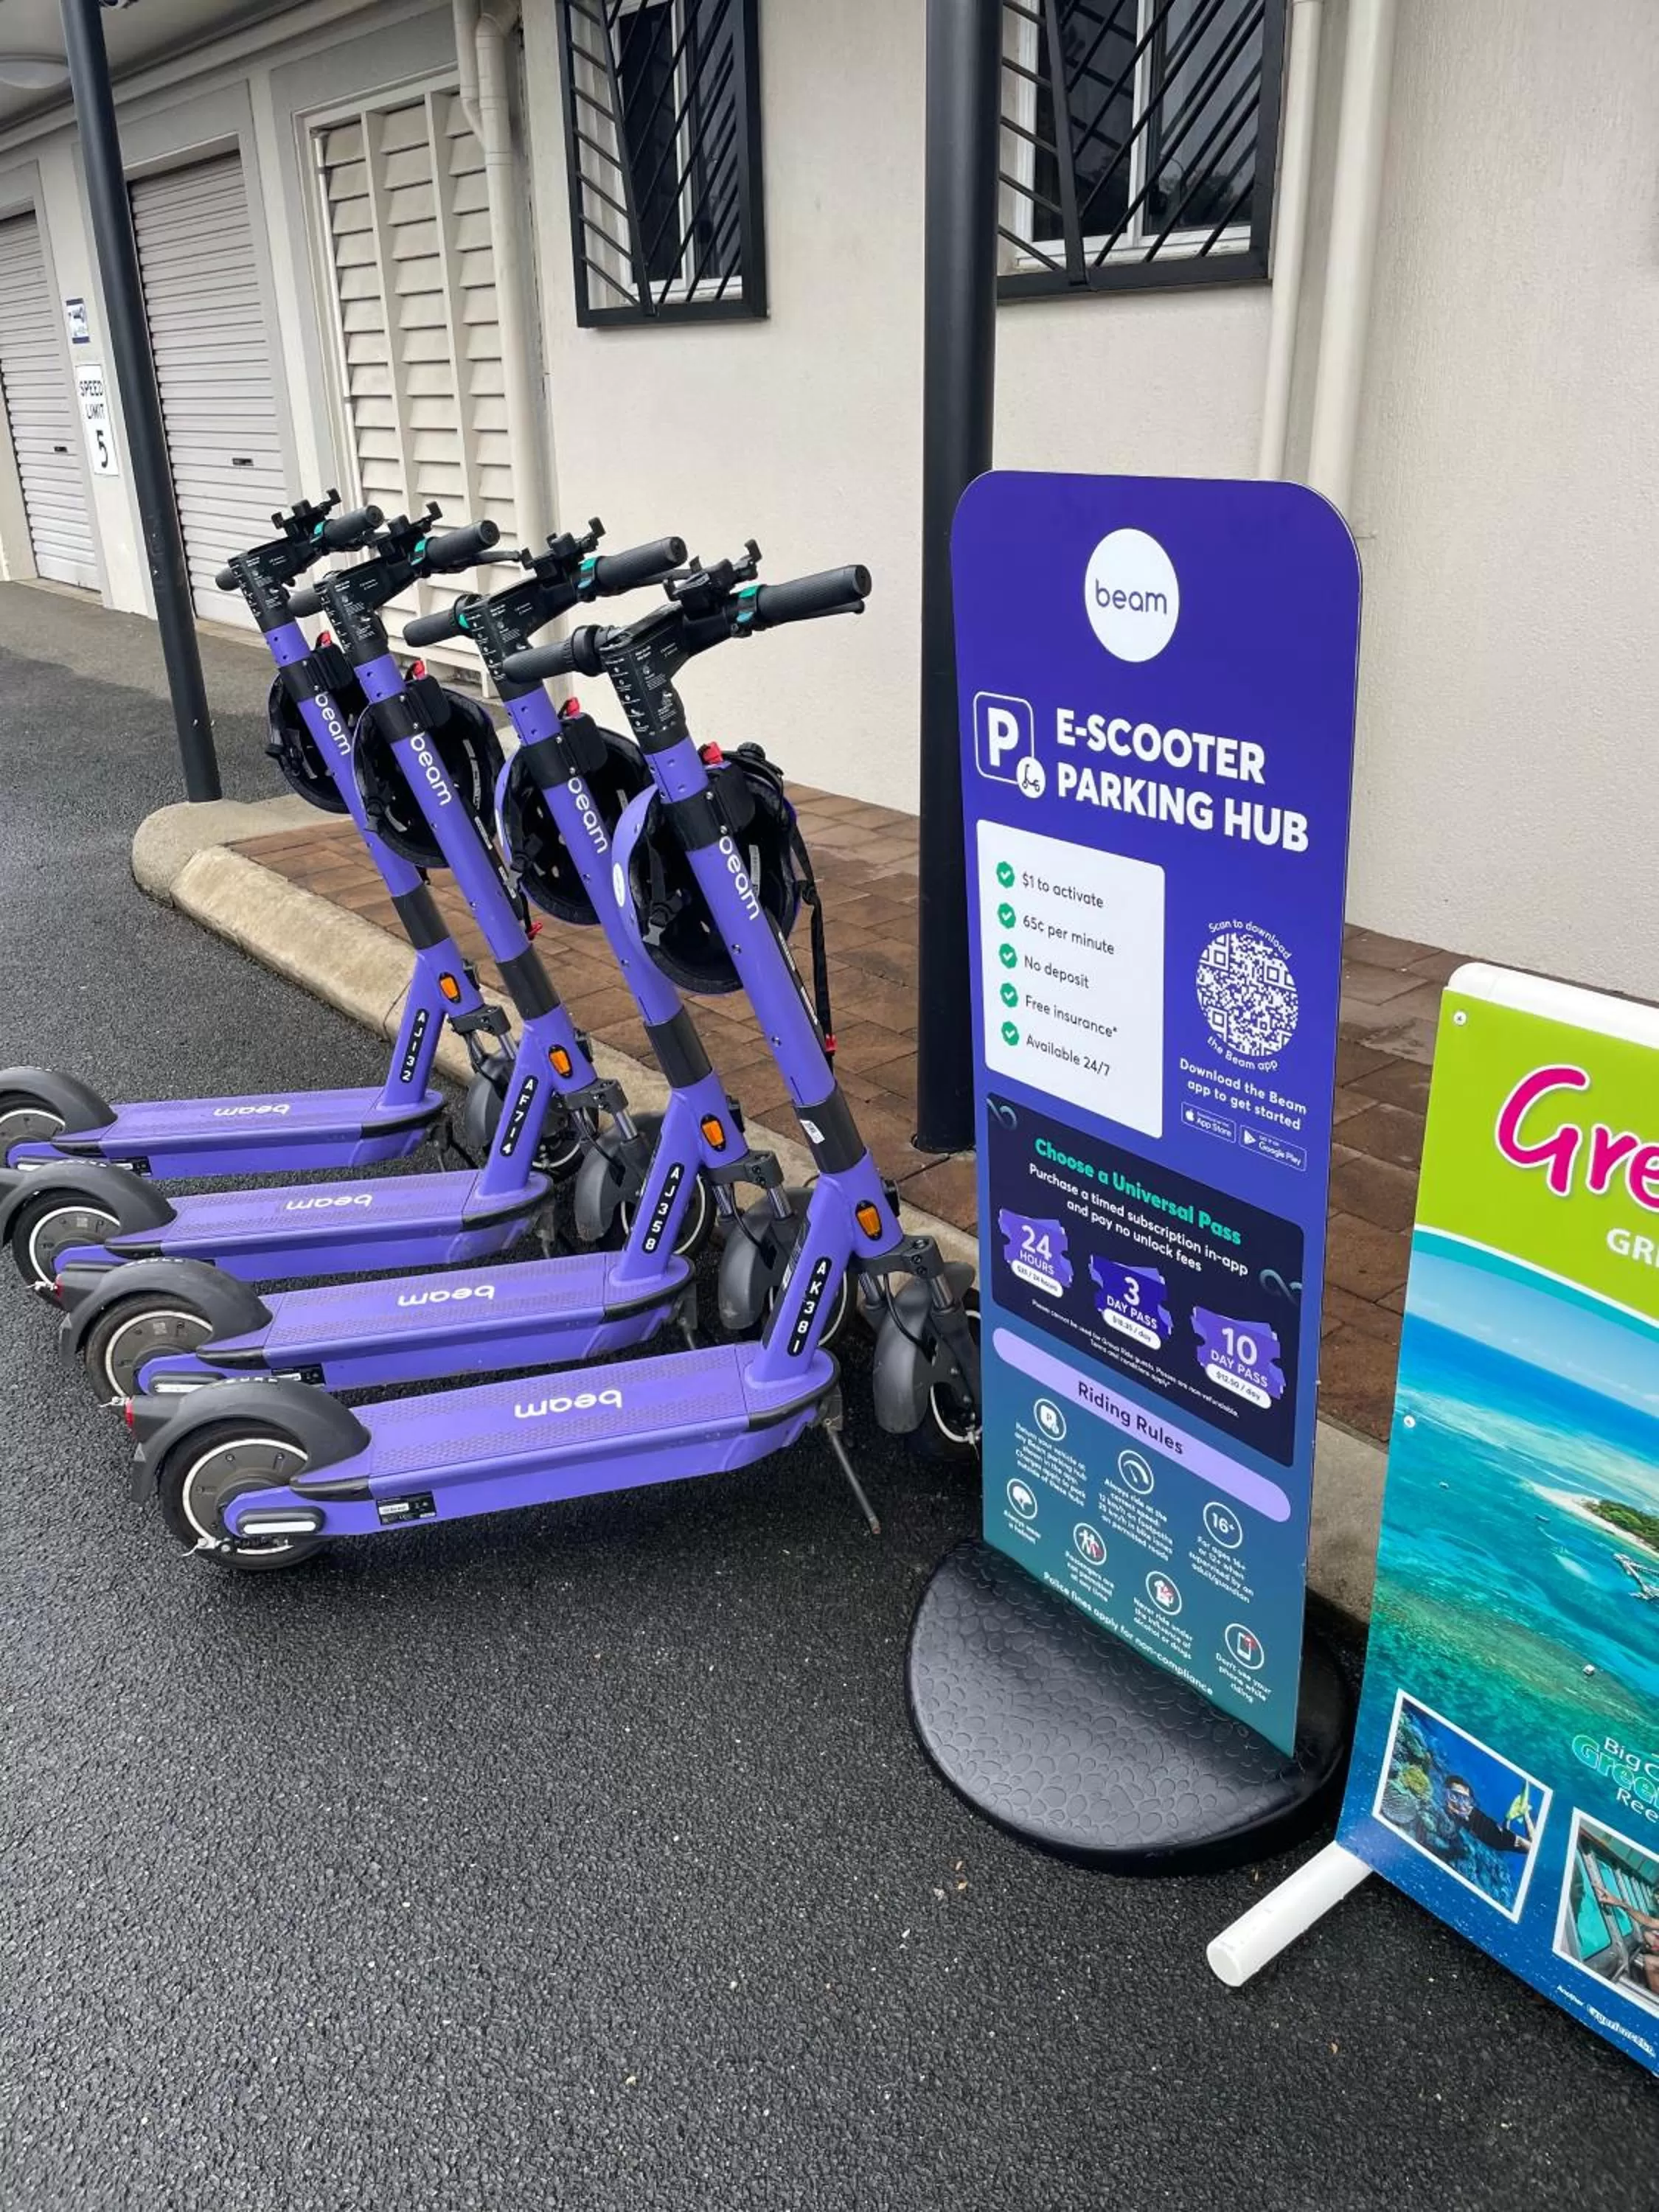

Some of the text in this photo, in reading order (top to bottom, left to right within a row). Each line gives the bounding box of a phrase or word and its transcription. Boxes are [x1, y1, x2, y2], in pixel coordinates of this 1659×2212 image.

[79, 380, 104, 397] SPEED
[86, 403, 106, 420] LIMIT
[96, 429, 108, 468] 5
[1095, 578, 1167, 614] beam
[315, 692, 351, 757] beam
[987, 707, 1018, 768] P
[1057, 708, 1266, 785] E-SCOOTER
[409, 731, 453, 806] beam
[1057, 762, 1309, 852] PARKING HUB
[1023, 871, 1104, 908] $1 to activate
[1047, 922, 1067, 944] per
[1071, 928, 1114, 955] minute
[1209, 919, 1292, 959] Scan to download
[1024, 955, 1090, 989] No deposit
[1026, 995, 1050, 1016] Free
[1026, 1035, 1110, 1077] Available 24/7
[1207, 1036, 1278, 1072] the Beam app
[1180, 1058, 1307, 1115] Download the Beam
[213, 1103, 291, 1117] beam
[1188, 1081, 1300, 1130] app to get started
[1197, 1118, 1211, 1129] App
[1212, 1122, 1231, 1137] Store
[1259, 1141, 1301, 1166] Google Play
[286, 1194, 372, 1211] beam
[645, 1166, 680, 1251] AJ358
[1035, 1138, 1242, 1245] Choose a Universal Pass
[1029, 1163, 1248, 1276] Purchase a timed subscription in-app
[1067, 1200, 1202, 1272] and pay no unlock fees
[1022, 1225, 1052, 1261] 24
[1606, 1227, 1659, 1267] GR
[1020, 1249, 1054, 1275] HOURS
[397, 1284, 495, 1307] beam
[1124, 1276, 1140, 1305] 3
[1107, 1295, 1157, 1329] DAY PASS
[1222, 1328, 1257, 1366] 10
[1211, 1350, 1268, 1388] DAY PASS
[514, 1389, 623, 1420] beam
[1079, 1382, 1183, 1455] Riding Rules
[1212, 1512, 1235, 1534] 16+
[1093, 1605, 1118, 1633] apply
[1120, 1624, 1133, 1641] for
[1135, 1635, 1213, 1697] non-compliance
[1604, 1736, 1641, 1772] Big
